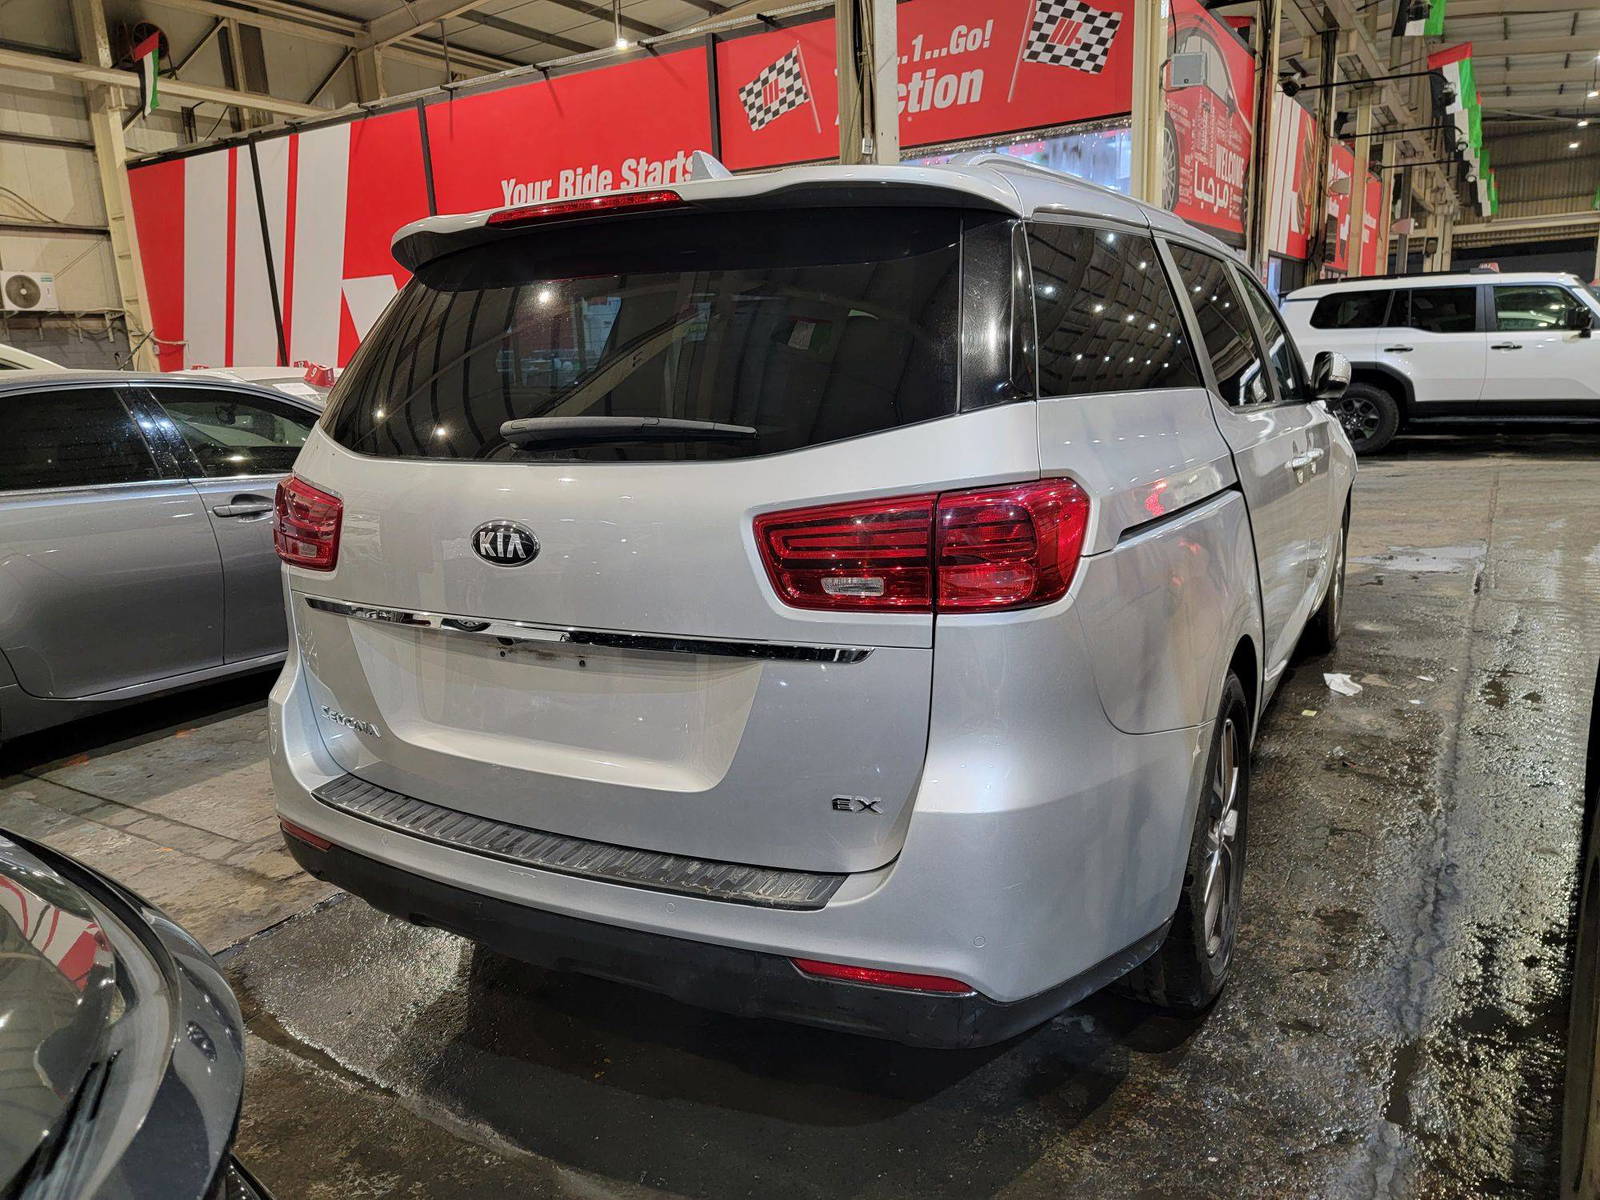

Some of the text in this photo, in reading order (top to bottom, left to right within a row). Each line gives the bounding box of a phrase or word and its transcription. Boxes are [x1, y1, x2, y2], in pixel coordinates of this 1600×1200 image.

[501, 177, 552, 208] Your
[559, 164, 613, 198] Ride
[1194, 160, 1230, 214] مرحبا
[1215, 143, 1245, 189] WELCOME
[479, 531, 527, 559] KIA
[831, 795, 882, 815] EX
